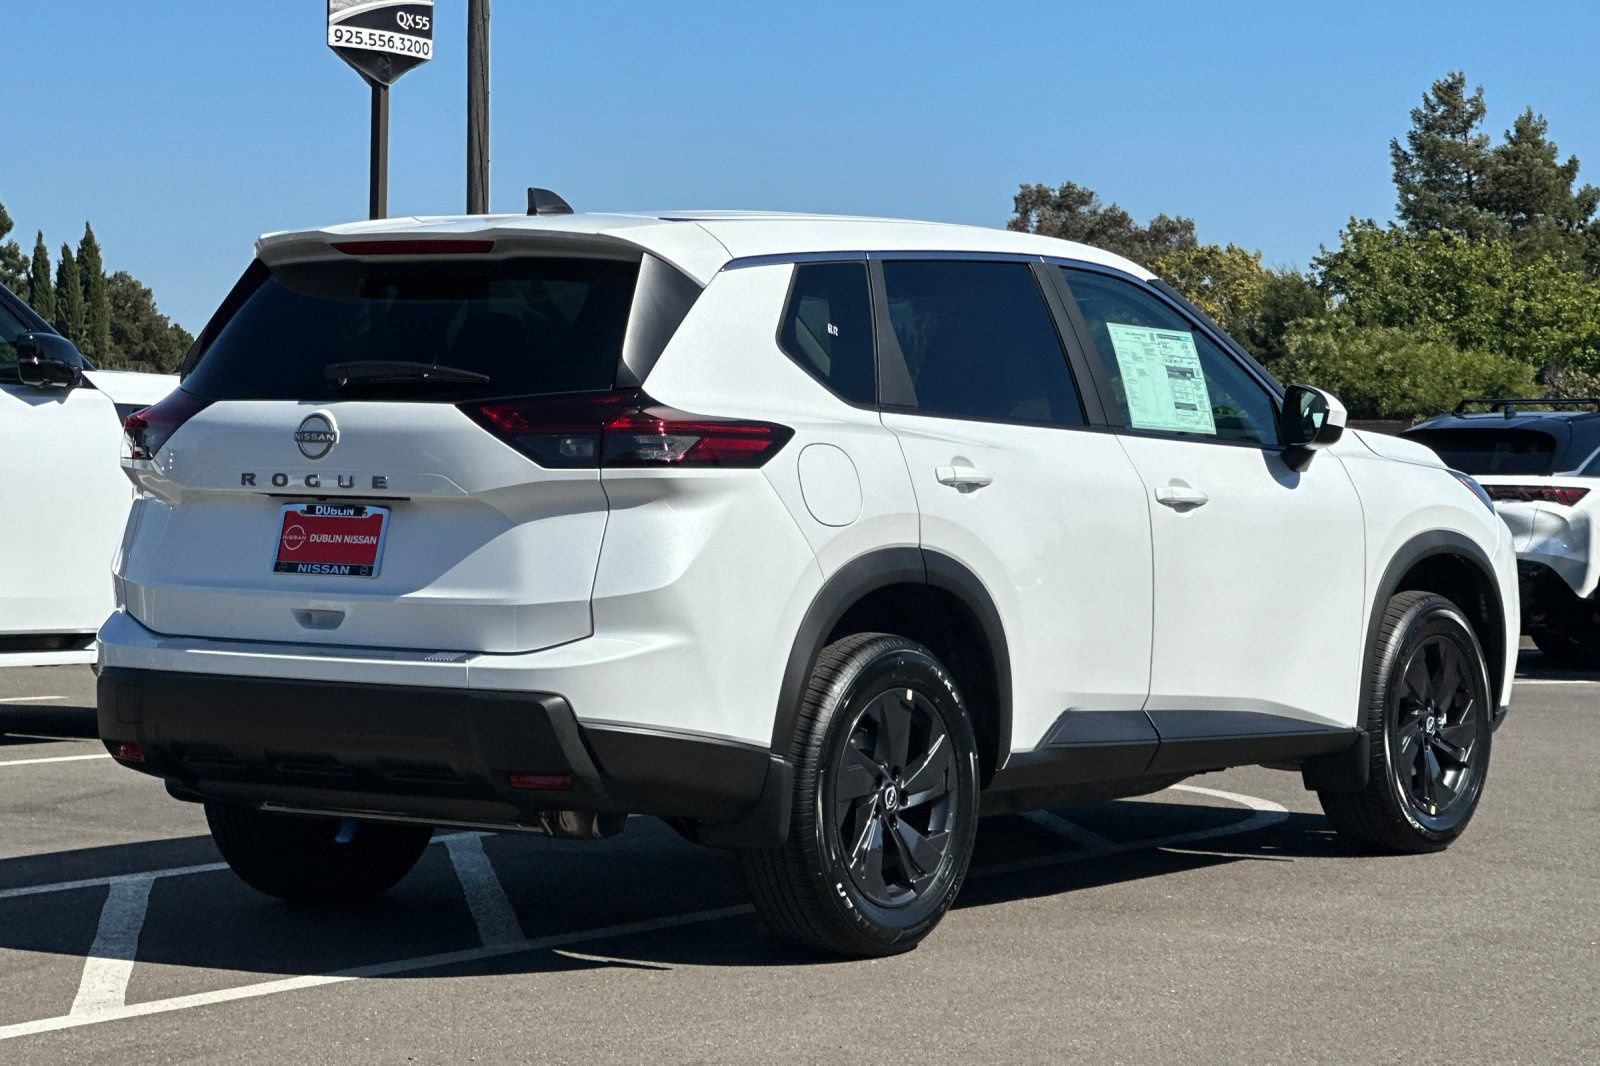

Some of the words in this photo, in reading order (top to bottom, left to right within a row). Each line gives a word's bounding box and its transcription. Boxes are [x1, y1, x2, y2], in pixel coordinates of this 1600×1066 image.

[396, 11, 430, 30] QX55
[334, 28, 430, 56] 925.556.3200
[295, 432, 335, 441] NISSAN
[240, 472, 388, 490] ROGUE
[315, 505, 355, 516] DUBLIN
[310, 533, 342, 543] DUBLIN
[343, 535, 377, 545] NISSAN
[297, 563, 351, 575] NISSAN
